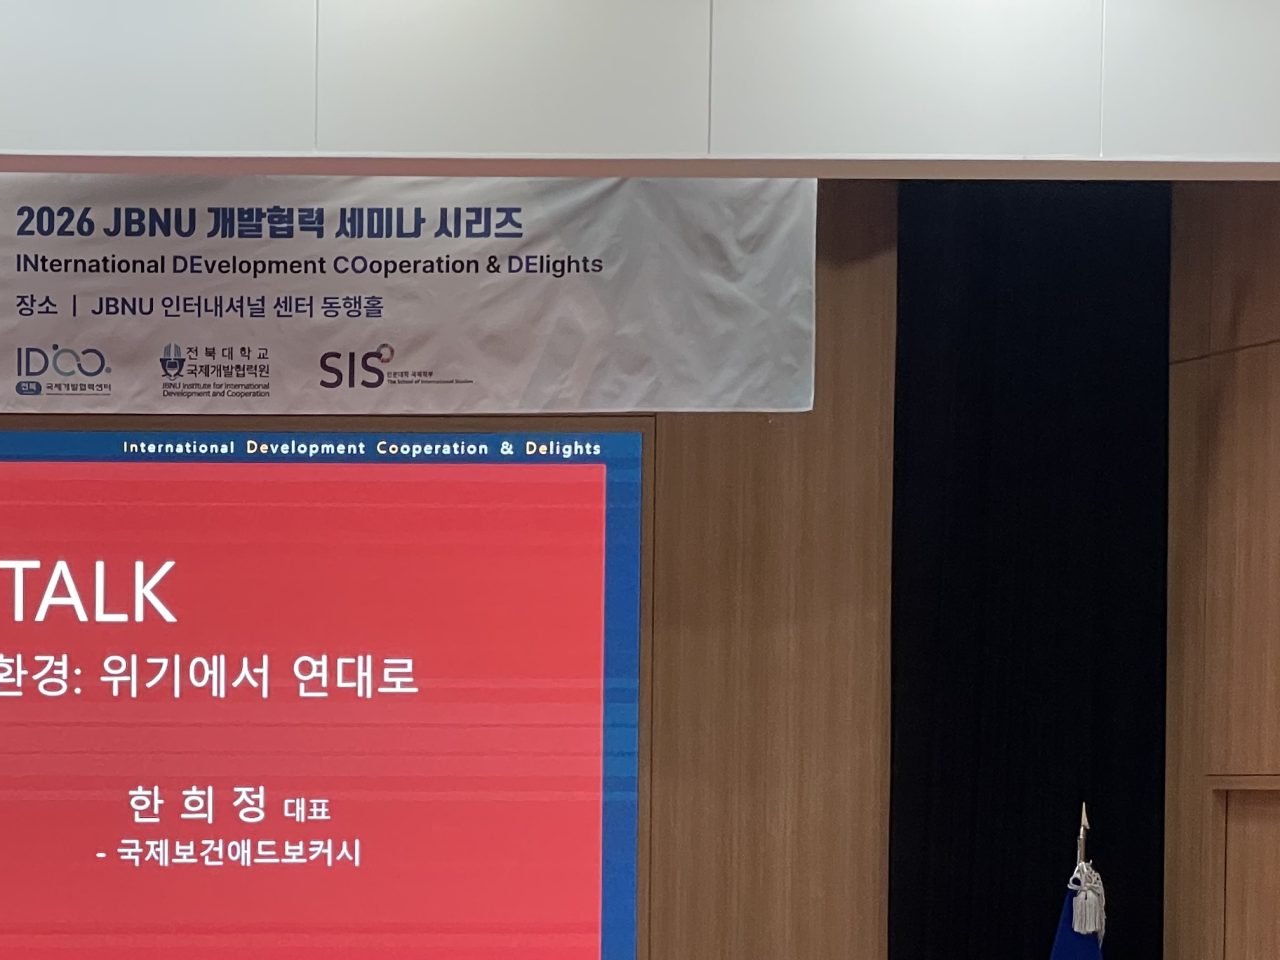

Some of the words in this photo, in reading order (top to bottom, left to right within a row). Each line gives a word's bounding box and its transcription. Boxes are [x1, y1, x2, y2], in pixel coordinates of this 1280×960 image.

[17, 206, 94, 236] 2026
[103, 207, 196, 237] JBNU
[207, 206, 324, 238] 개발협력
[335, 207, 426, 238] 세미나
[434, 207, 523, 238] 시리즈
[17, 254, 164, 273] INternational
[173, 256, 326, 278] DEvelopment
[334, 255, 478, 278] COoperation
[487, 256, 500, 273] &
[509, 255, 603, 278] DElights
[17, 294, 58, 316] 장소
[91, 297, 153, 315] JBNU
[162, 296, 265, 317] 인터내셔널
[274, 296, 313, 318] 센터
[321, 296, 383, 317] 동행홀
[186, 346, 269, 360] 전북대학교
[186, 364, 270, 378] 국제개발협력원
[320, 351, 385, 389] SIS
[46, 383, 111, 391] 국제개발협력센터
[162, 390, 210, 398] Development
[226, 390, 270, 398] Cooperation
[224, 382, 270, 390] International
[124, 441, 234, 453] International
[247, 440, 365, 457] Development
[377, 441, 487, 457] Cooperation
[501, 441, 513, 454] &
[526, 441, 600, 458] Delights
[100, 654, 268, 698] 위기에서
[294, 655, 418, 698] 연대로
[284, 798, 330, 822] 대표
[117, 839, 359, 866] 국제보건애드보커시
